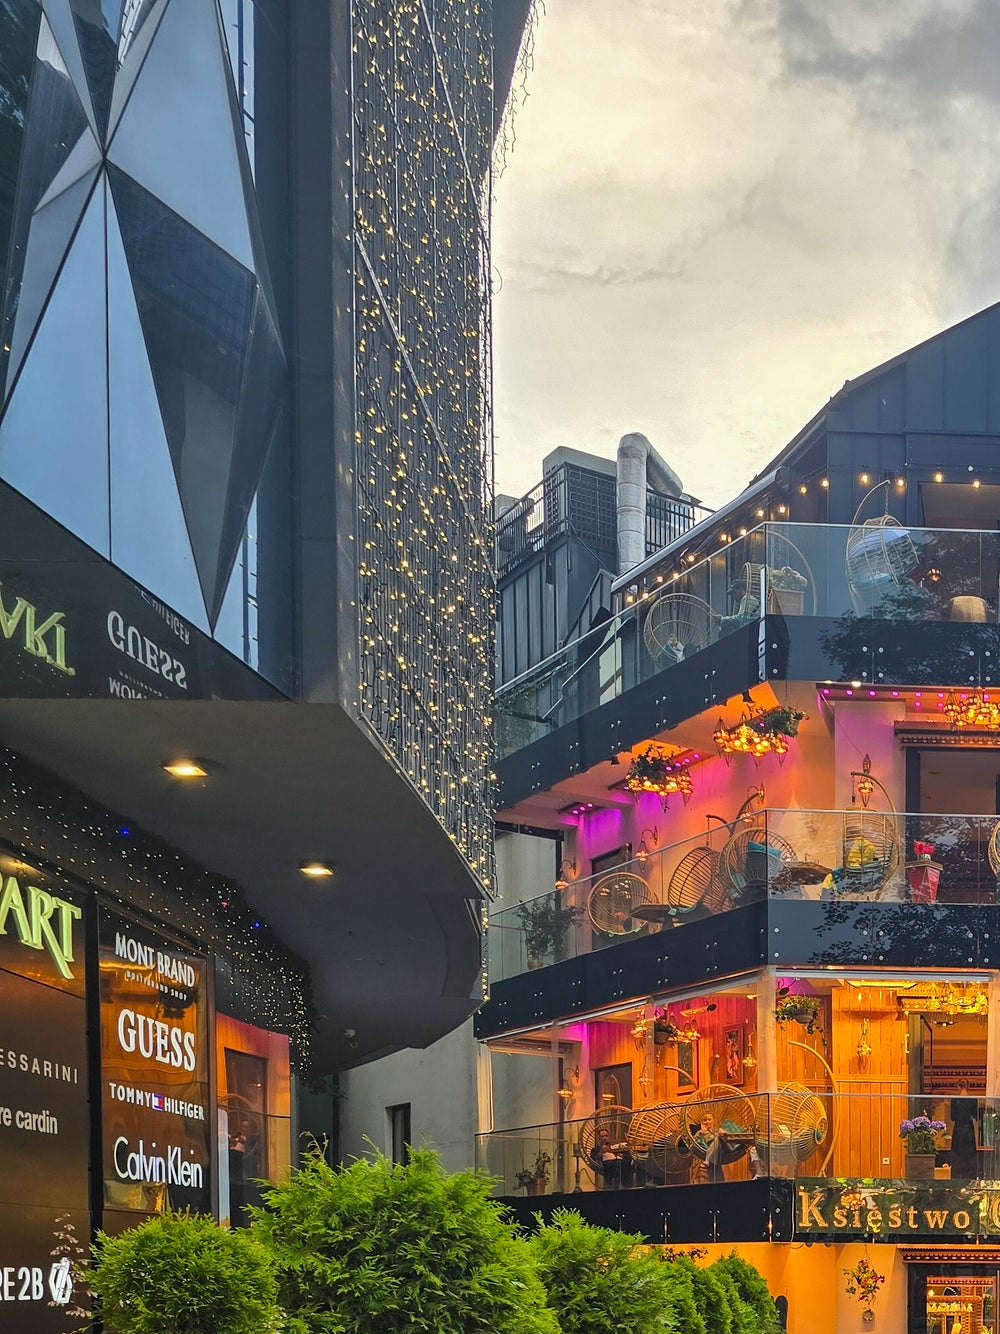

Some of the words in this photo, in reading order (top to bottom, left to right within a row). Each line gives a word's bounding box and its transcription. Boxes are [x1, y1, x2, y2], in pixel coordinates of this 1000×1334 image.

[0, 872, 82, 979] ART
[115, 932, 155, 970] MONT
[157, 951, 195, 988] BRAND
[170, 989, 187, 1001] SHOP
[117, 1008, 196, 1072] GUESS
[15, 1110, 58, 1135] cardin
[109, 1082, 151, 1108] TOMMY
[164, 1097, 205, 1121] HILFIGER
[113, 1136, 167, 1183] Calvin
[167, 1145, 203, 1189] Klein
[798, 1191, 971, 1233] Księstwo
